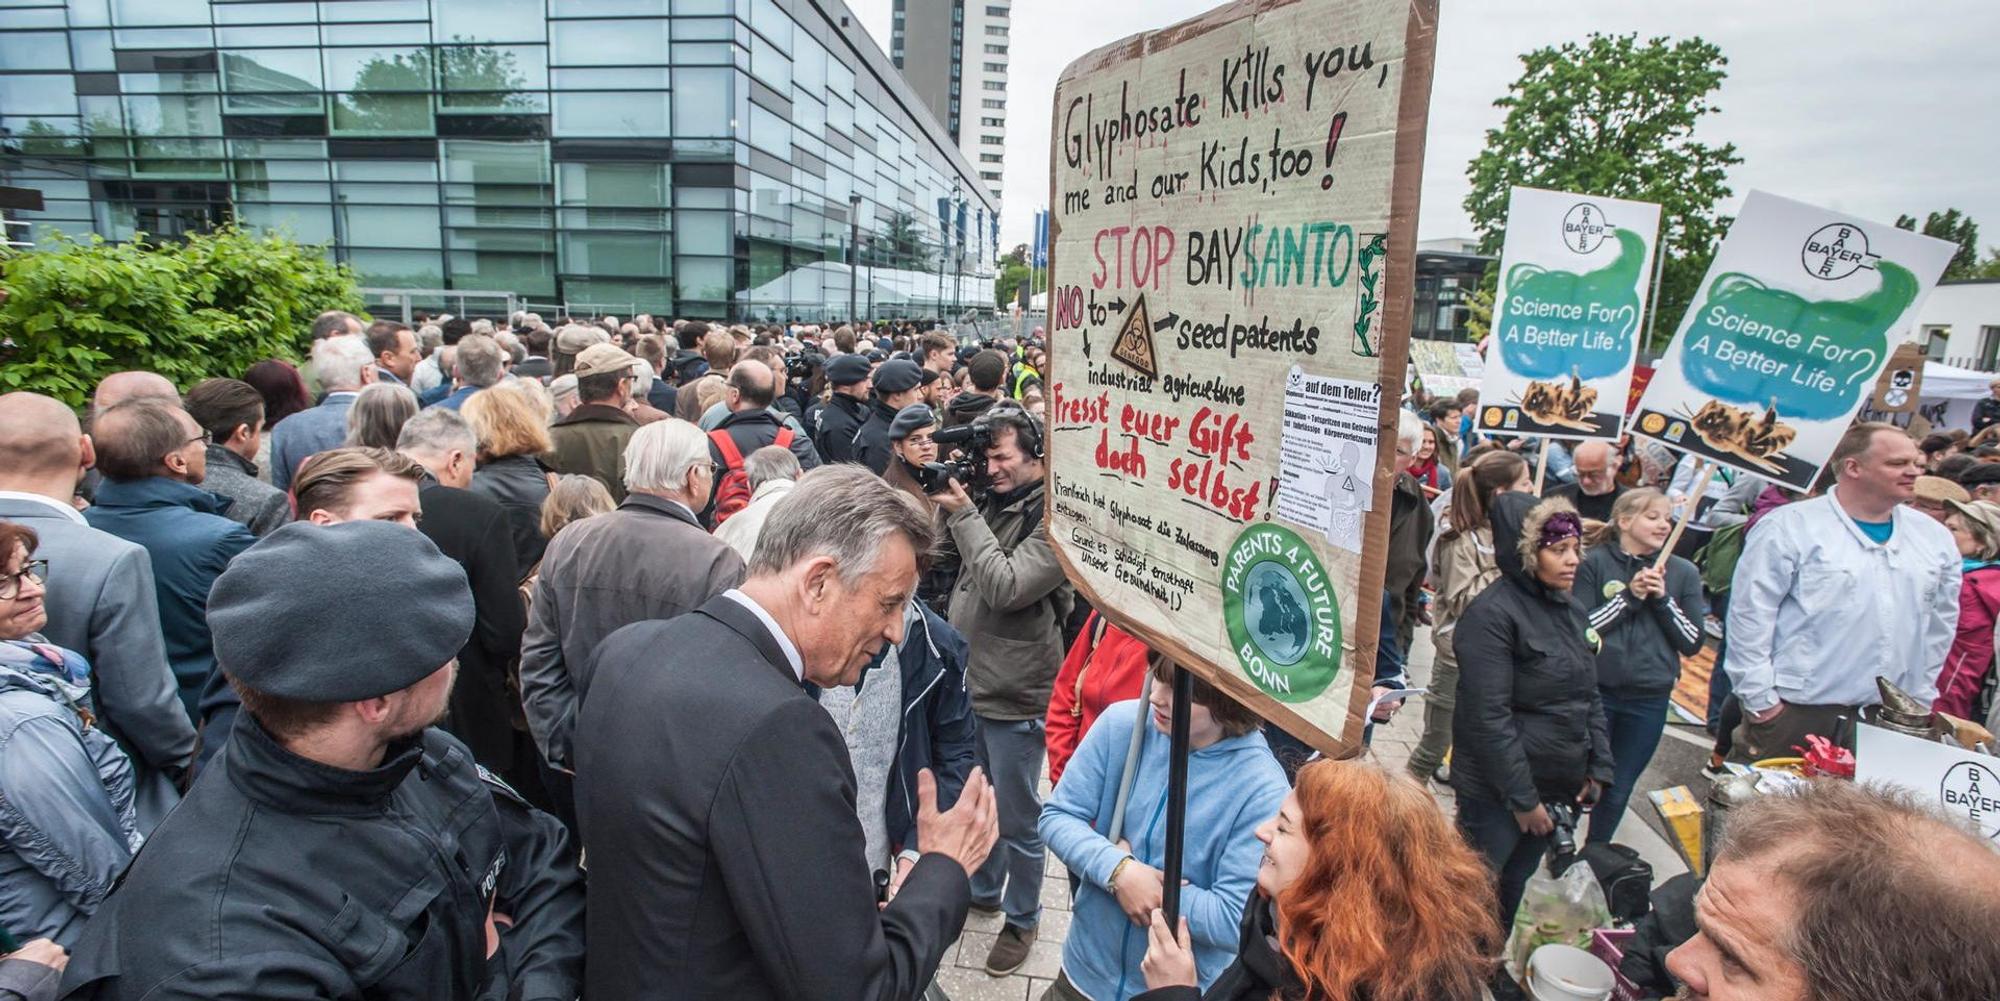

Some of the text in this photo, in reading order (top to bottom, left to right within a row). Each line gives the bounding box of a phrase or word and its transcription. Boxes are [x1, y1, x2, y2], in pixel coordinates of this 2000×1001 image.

[1064, 41, 1388, 181] Glyphosate Kills you,
[1065, 188, 1090, 215] me
[1105, 169, 1138, 205] and
[1152, 170, 1189, 202] our
[1092, 224, 1175, 292] STOP
[1808, 241, 1863, 264] BAYER
[1819, 228, 1851, 277] BAYER
[1056, 284, 1107, 331] NO to
[1510, 296, 1583, 321] Science
[1706, 306, 1802, 348] Science
[1506, 326, 1519, 343] A
[1524, 328, 1579, 347] Better
[1690, 335, 1711, 355] A
[1714, 340, 1788, 379] Better
[1088, 362, 1246, 407] industrial agriculture
[1305, 381, 1320, 394] auf
[1320, 382, 1341, 397] dem
[1053, 382, 1110, 424] Fresst
[1120, 404, 1180, 443] euer
[1188, 406, 1255, 463] Gift
[1095, 432, 1147, 480] doch
[1097, 541, 1108, 555] es
[1157, 520, 1171, 538] die
[1226, 532, 1332, 661] PARENTS 4 FUTURE
[1239, 642, 1291, 696] BONN
